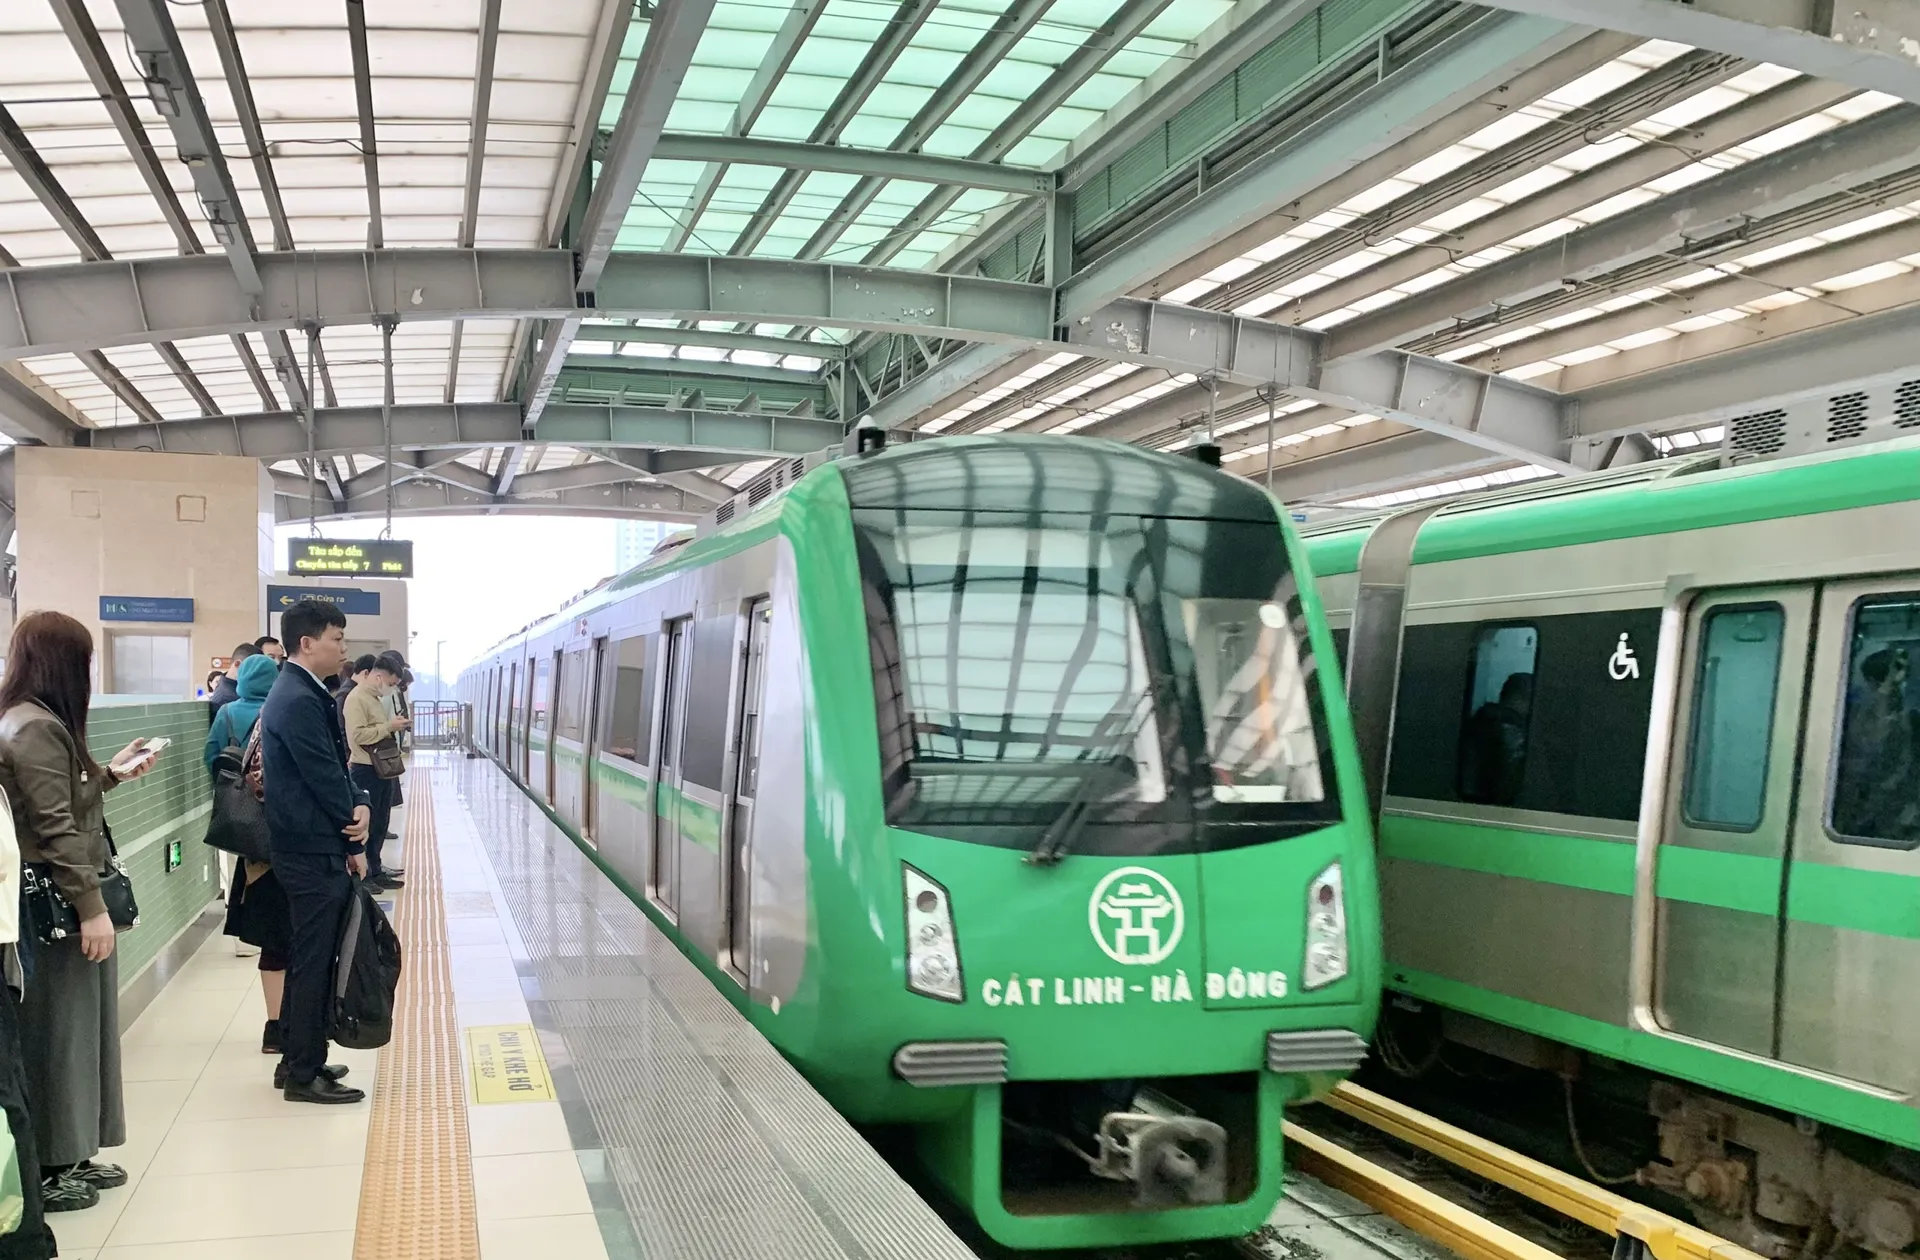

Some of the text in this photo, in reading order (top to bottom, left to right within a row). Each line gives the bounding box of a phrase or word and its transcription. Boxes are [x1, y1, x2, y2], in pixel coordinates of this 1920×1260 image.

[363, 561, 371, 571] 7
[336, 595, 345, 603] ra
[982, 972, 1045, 1006] CÁT
[1055, 976, 1124, 1005] LINH
[1151, 968, 1193, 1003] HÀ
[1206, 967, 1288, 999] ĐÔNG
[504, 1056, 529, 1075] KHE
